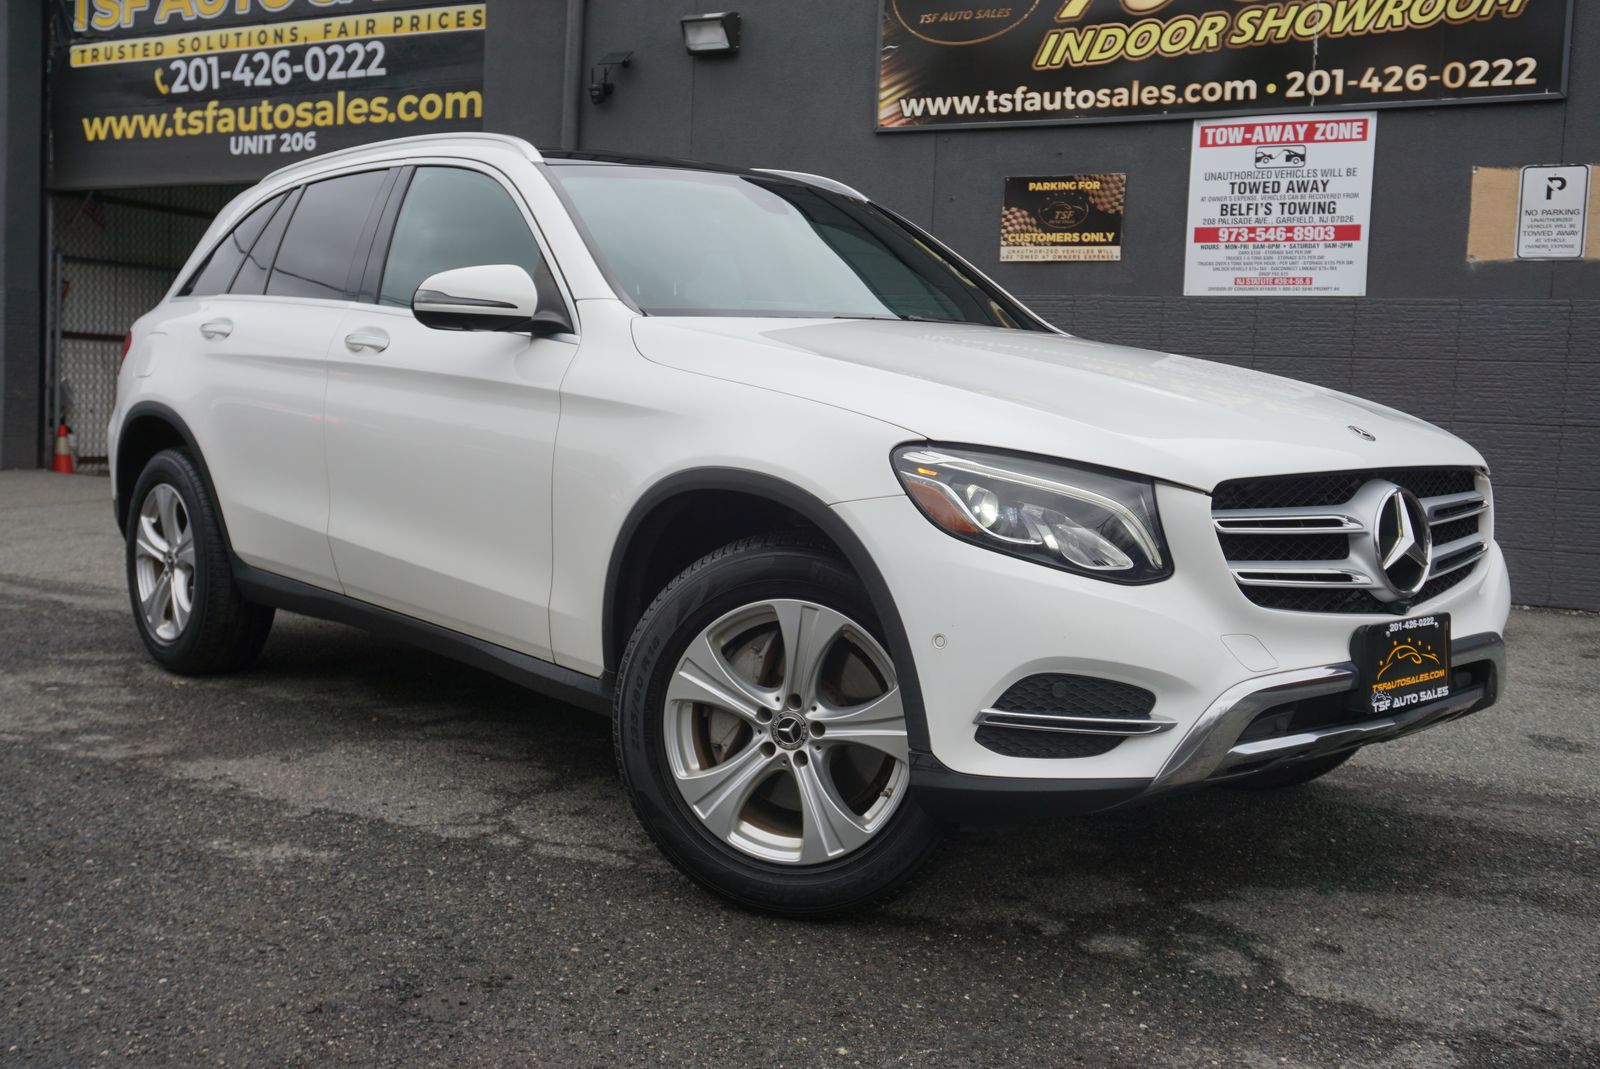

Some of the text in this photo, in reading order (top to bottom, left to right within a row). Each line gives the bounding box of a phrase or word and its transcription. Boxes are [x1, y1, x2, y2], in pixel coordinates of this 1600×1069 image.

[919, 8, 1012, 24] TSF AUTO SALES
[78, 9, 483, 64] TRUSTED SOLUTIONS, FAIR PRICES
[1033, 14, 1231, 70] INDOOR
[169, 40, 387, 94] 201-426-0222
[900, 57, 1538, 118] www.tsfautosales.com 201-426-0222
[82, 90, 483, 142] www.tsfautosales.com
[1205, 121, 1364, 145] TOW-AWAY ZONE
[229, 131, 317, 156] UNIT 206
[1204, 167, 1358, 181] UNAUTHORIZED VEHICLES WILL BE
[1028, 181, 1101, 191] PARKING FOR
[1229, 179, 1330, 195] TOWED AWAY
[1308, 192, 1342, 200] RECOVERED
[1055, 210, 1075, 220] TSF
[1220, 200, 1336, 217] BELFI'S TOWING
[1541, 208, 1580, 216] PARKING
[1202, 217, 1217, 226] 208
[1218, 216, 1253, 225] PALISADE
[1318, 215, 1329, 223] NJ
[1331, 215, 1355, 223] 07026
[1008, 231, 1115, 242] CUSTOMERS ONLY
[1218, 226, 1336, 242] 973-546-8903
[1236, 278, 1245, 286] NJ
[1246, 277, 1273, 285] STATUTE
[1389, 616, 1435, 632] 201-426-0222
[1371, 669, 1446, 693] TSFAUTOSALES.COM
[1371, 686, 1449, 713] TSF AUTO SALES
